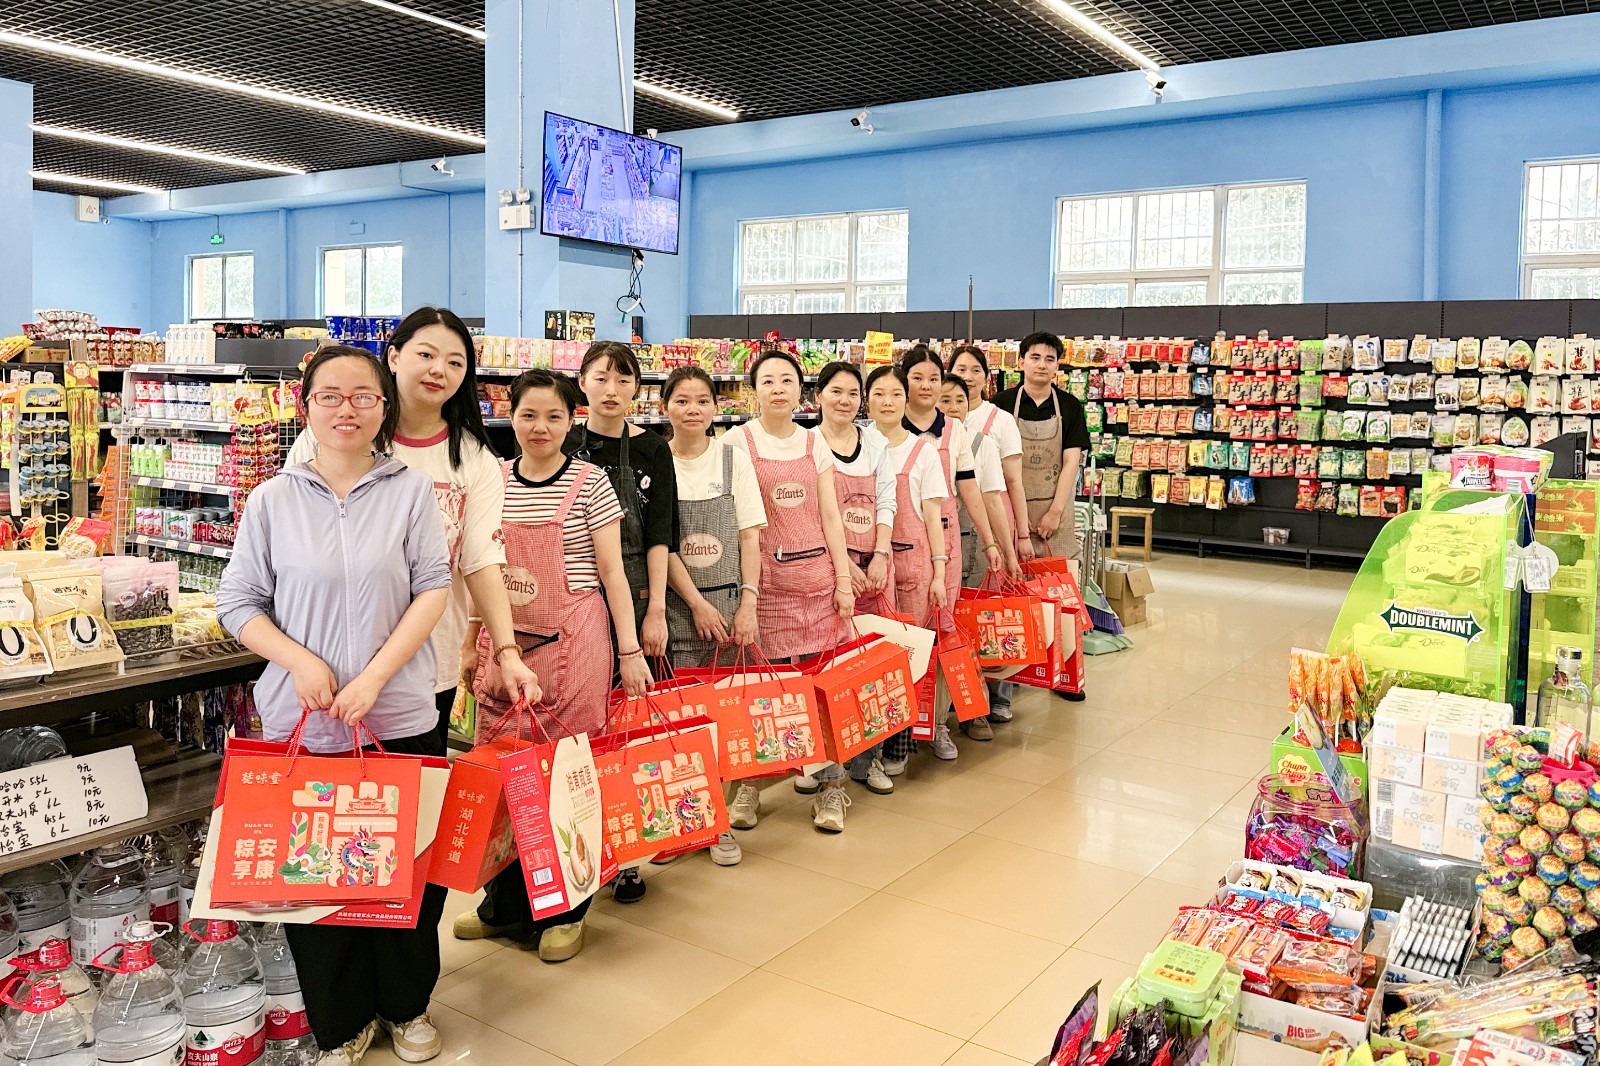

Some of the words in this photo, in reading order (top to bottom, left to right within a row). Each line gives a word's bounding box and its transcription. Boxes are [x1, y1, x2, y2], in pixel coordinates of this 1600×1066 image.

[776, 487, 804, 499] Plants
[846, 511, 871, 525] Plants
[684, 542, 718, 556] Plants
[503, 574, 535, 595] Plants
[1416, 608, 1447, 617] WRIGLEY'S
[1389, 609, 1474, 635] DOUBLEMINT
[1418, 638, 1446, 647] Dove
[77, 763, 92, 773] 9元
[1281, 760, 1308, 772] Chupa
[81, 774, 96, 785] 9元
[84, 786, 102, 797] 10元
[86, 799, 105, 812] 8元
[88, 814, 111, 828] 10元
[1403, 807, 1435, 823] Face
[446, 807, 475, 865] 湖北味道
[1286, 1024, 1305, 1039] BIG
[187, 1051, 220, 1062] 农夫山泉
